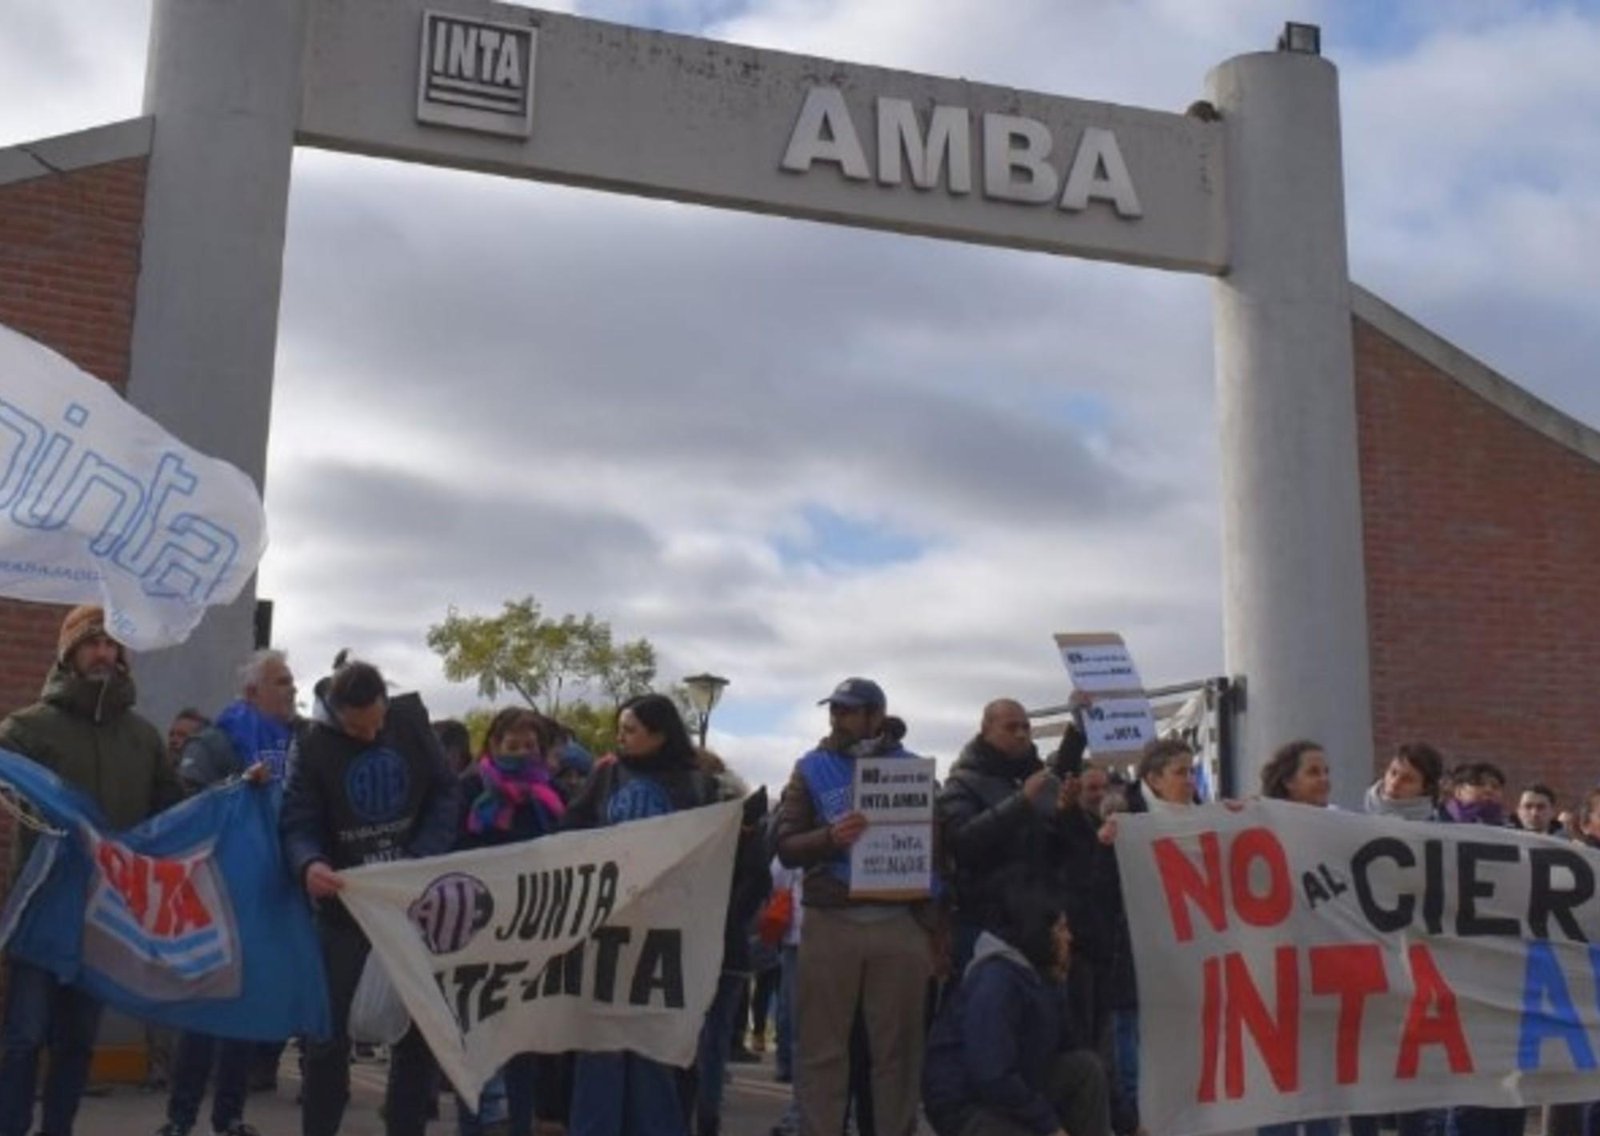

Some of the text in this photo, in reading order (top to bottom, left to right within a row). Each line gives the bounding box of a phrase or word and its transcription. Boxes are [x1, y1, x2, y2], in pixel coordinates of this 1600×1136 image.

[433, 21, 521, 87] INTA
[780, 86, 1143, 219] AMBA
[496, 861, 620, 941] JUNTA
[1153, 827, 1596, 944] NO AL CIER
[1197, 938, 1600, 1103] INTA A
